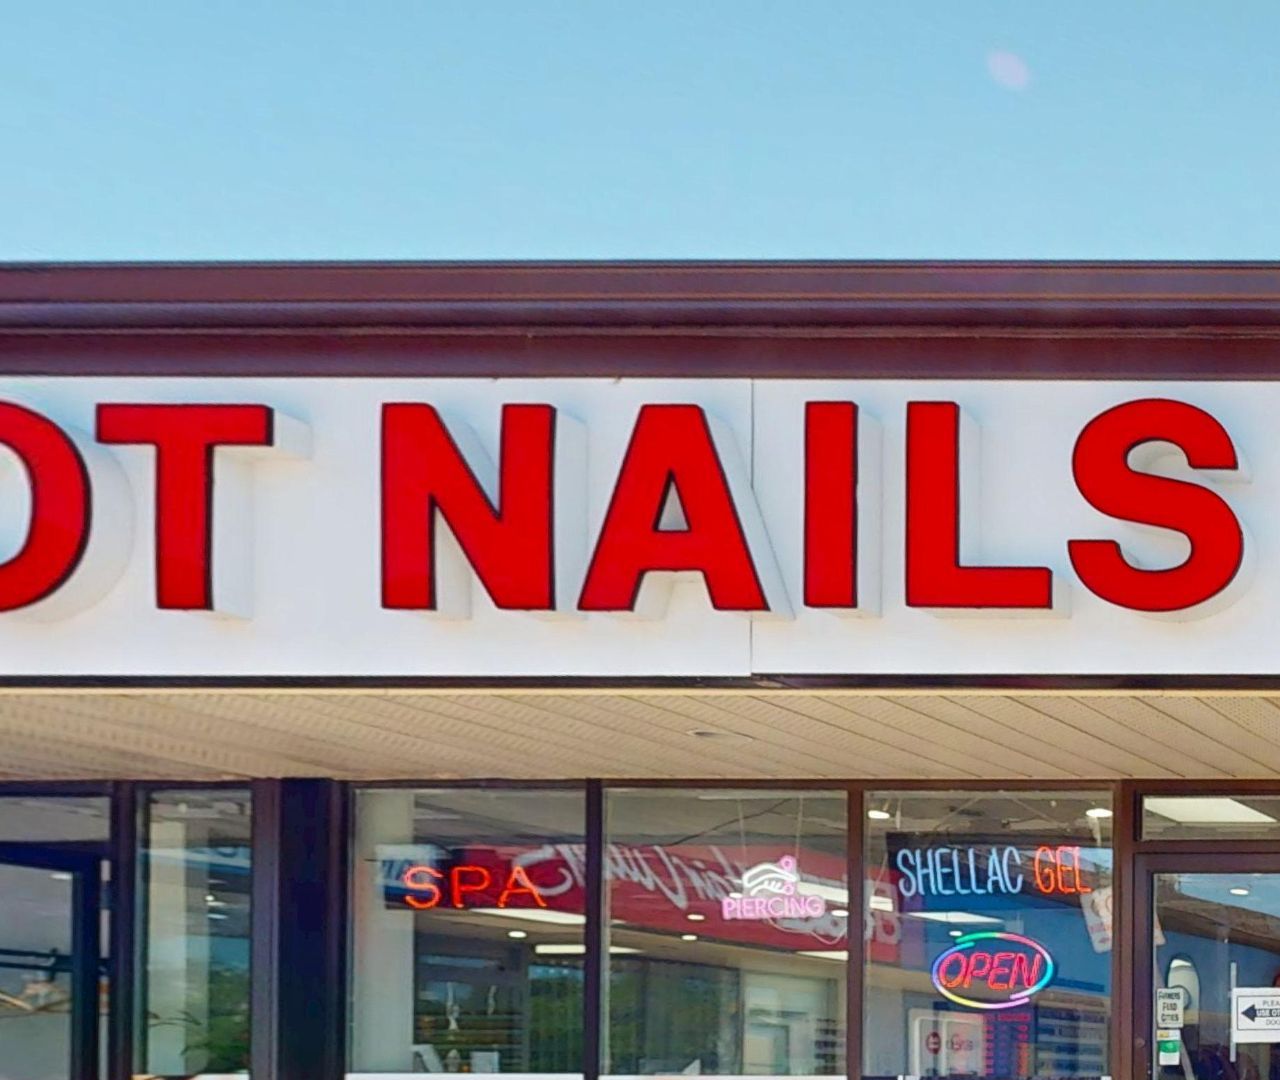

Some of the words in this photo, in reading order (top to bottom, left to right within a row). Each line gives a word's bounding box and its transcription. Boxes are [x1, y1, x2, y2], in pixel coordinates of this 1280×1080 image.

[380, 397, 1244, 612] NAILS
[402, 864, 548, 910] SPA
[897, 845, 1023, 898] SHELLAC
[1033, 844, 1093, 894] GEL
[722, 893, 826, 921] PIERCING
[938, 951, 1043, 991] OPEN
[1256, 1009, 1271, 1017] USE
